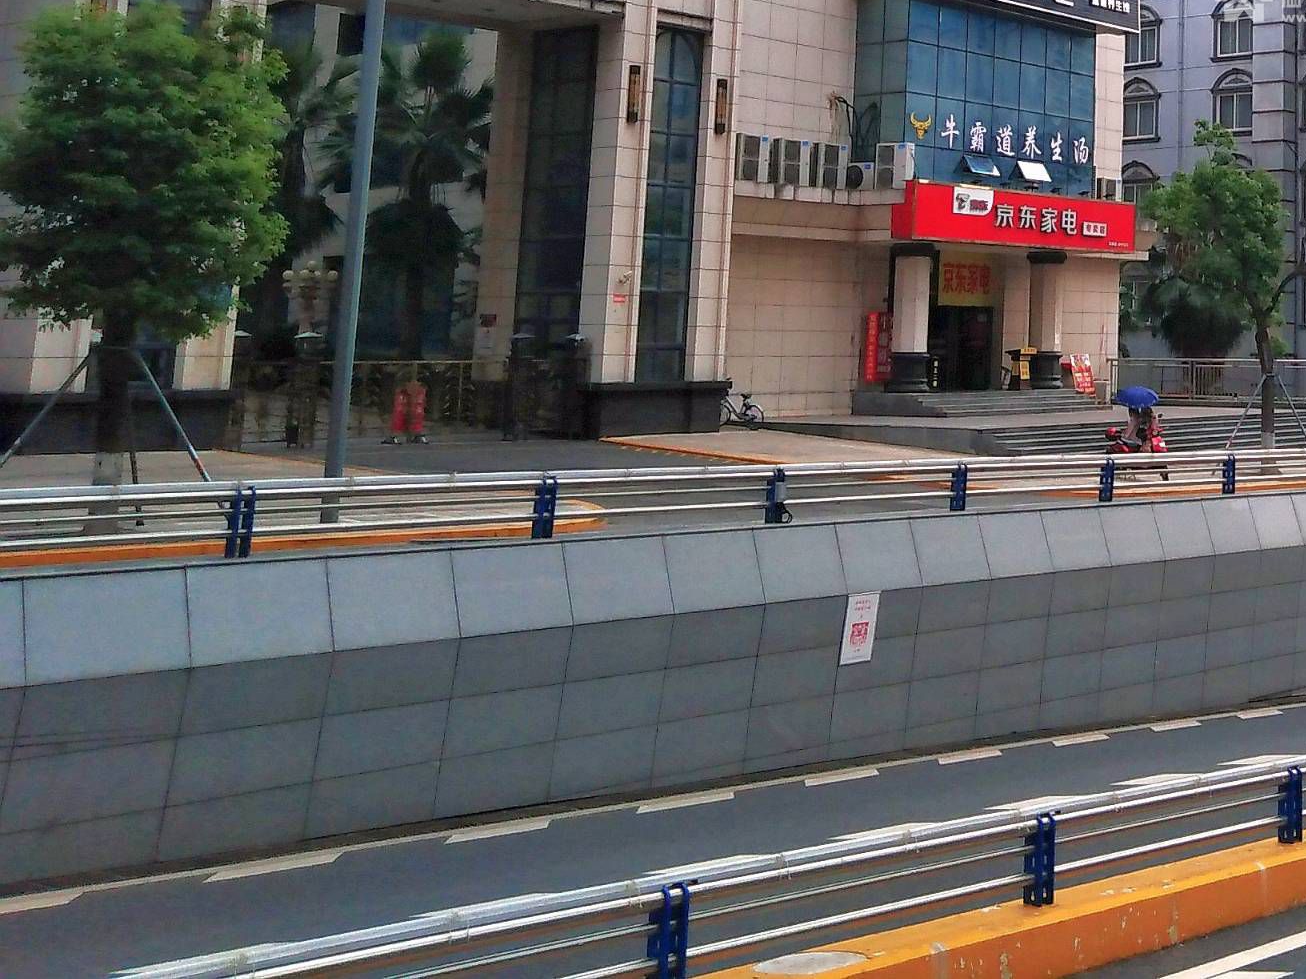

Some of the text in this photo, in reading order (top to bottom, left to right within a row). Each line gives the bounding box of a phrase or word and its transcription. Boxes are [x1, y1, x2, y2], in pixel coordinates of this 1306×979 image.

[941, 114, 1089, 164] 牛霸道养生汤
[995, 204, 1078, 235] 京东家电
